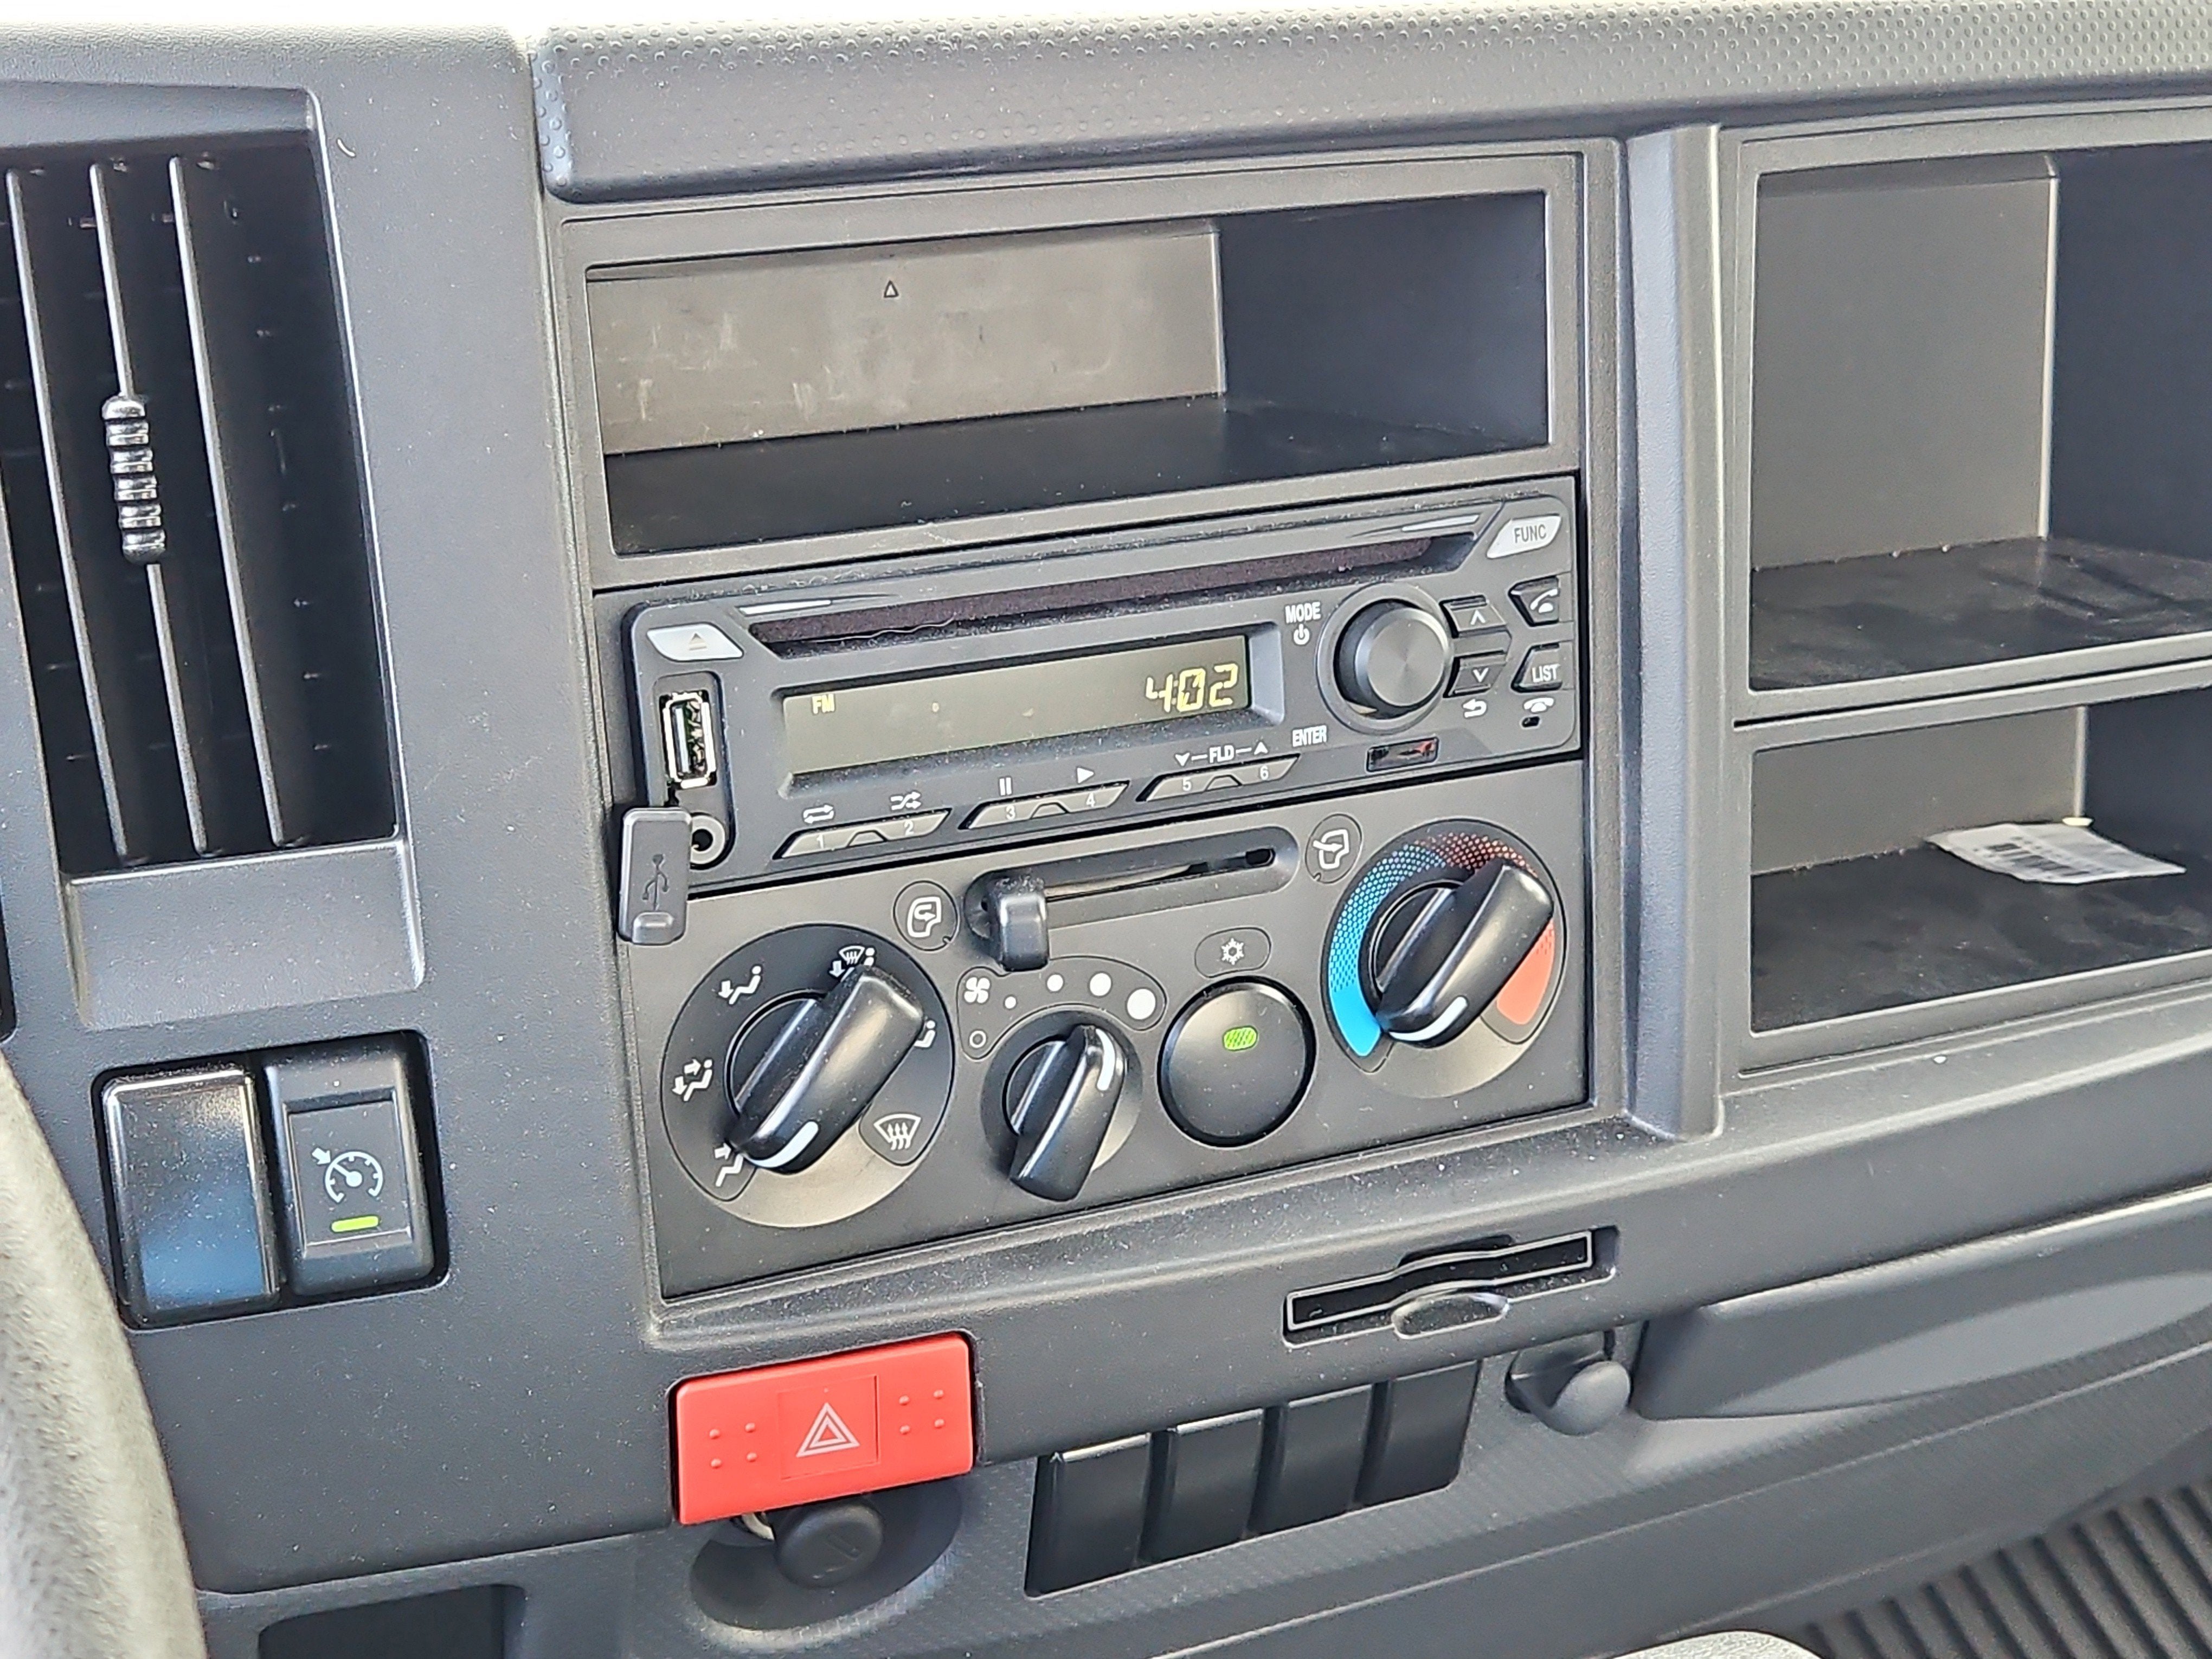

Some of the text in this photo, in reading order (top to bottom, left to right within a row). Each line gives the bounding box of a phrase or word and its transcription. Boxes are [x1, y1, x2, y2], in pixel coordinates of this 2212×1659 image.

[1514, 523, 1547, 543] FUNC
[1285, 601, 1321, 623] MODE
[1532, 663, 1559, 682] LIST
[812, 693, 835, 715] FM
[1292, 724, 1327, 748] ENTER
[1209, 744, 1234, 764] FLD
[1259, 765, 1269, 780] 6
[1182, 777, 1192, 792] 5
[1085, 793, 1095, 808] 4
[1006, 805, 1016, 820] 3
[903, 821, 914, 835] 2
[816, 835, 825, 849] 1
